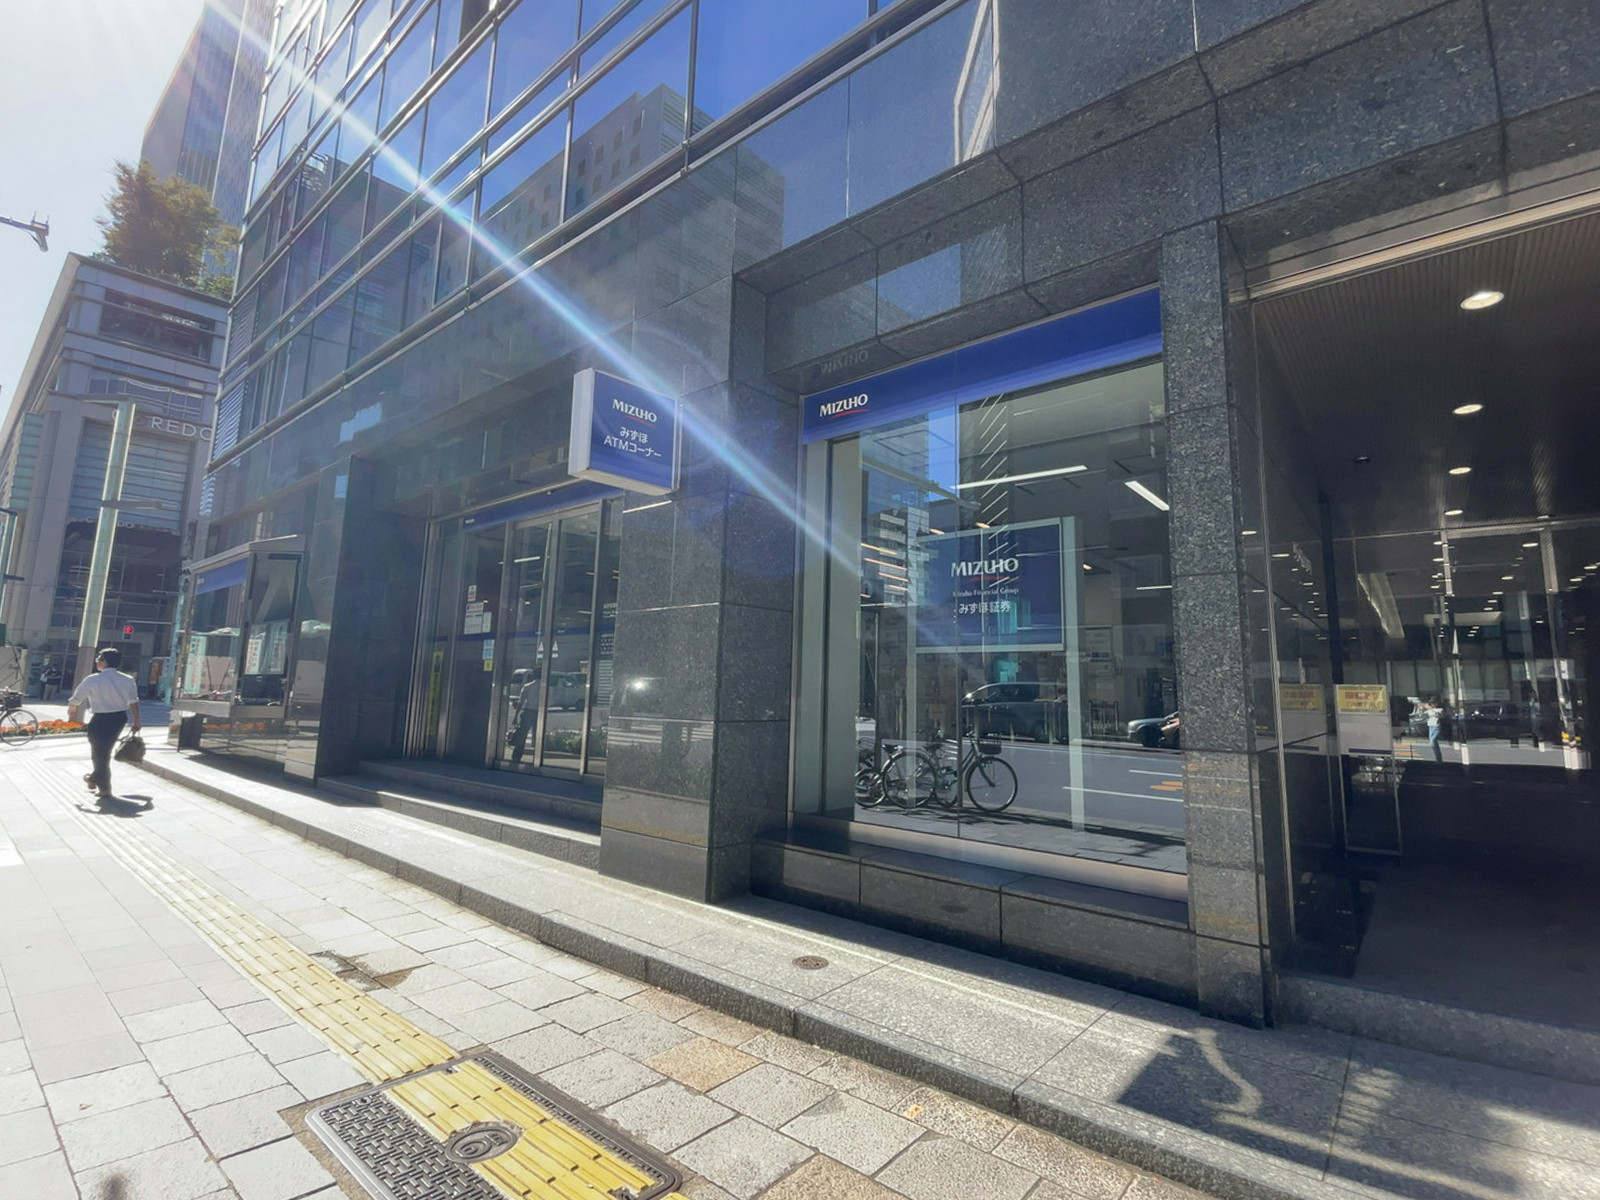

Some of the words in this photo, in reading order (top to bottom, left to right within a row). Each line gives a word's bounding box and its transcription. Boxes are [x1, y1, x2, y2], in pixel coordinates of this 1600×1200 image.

[612, 398, 658, 423] MIZUHO
[819, 393, 869, 418] MIZUHO
[619, 426, 649, 444] みずほ
[603, 435, 662, 457] ATMコーナー
[950, 557, 1019, 578] MIZUHO
[958, 600, 1011, 615] みずほ証券
